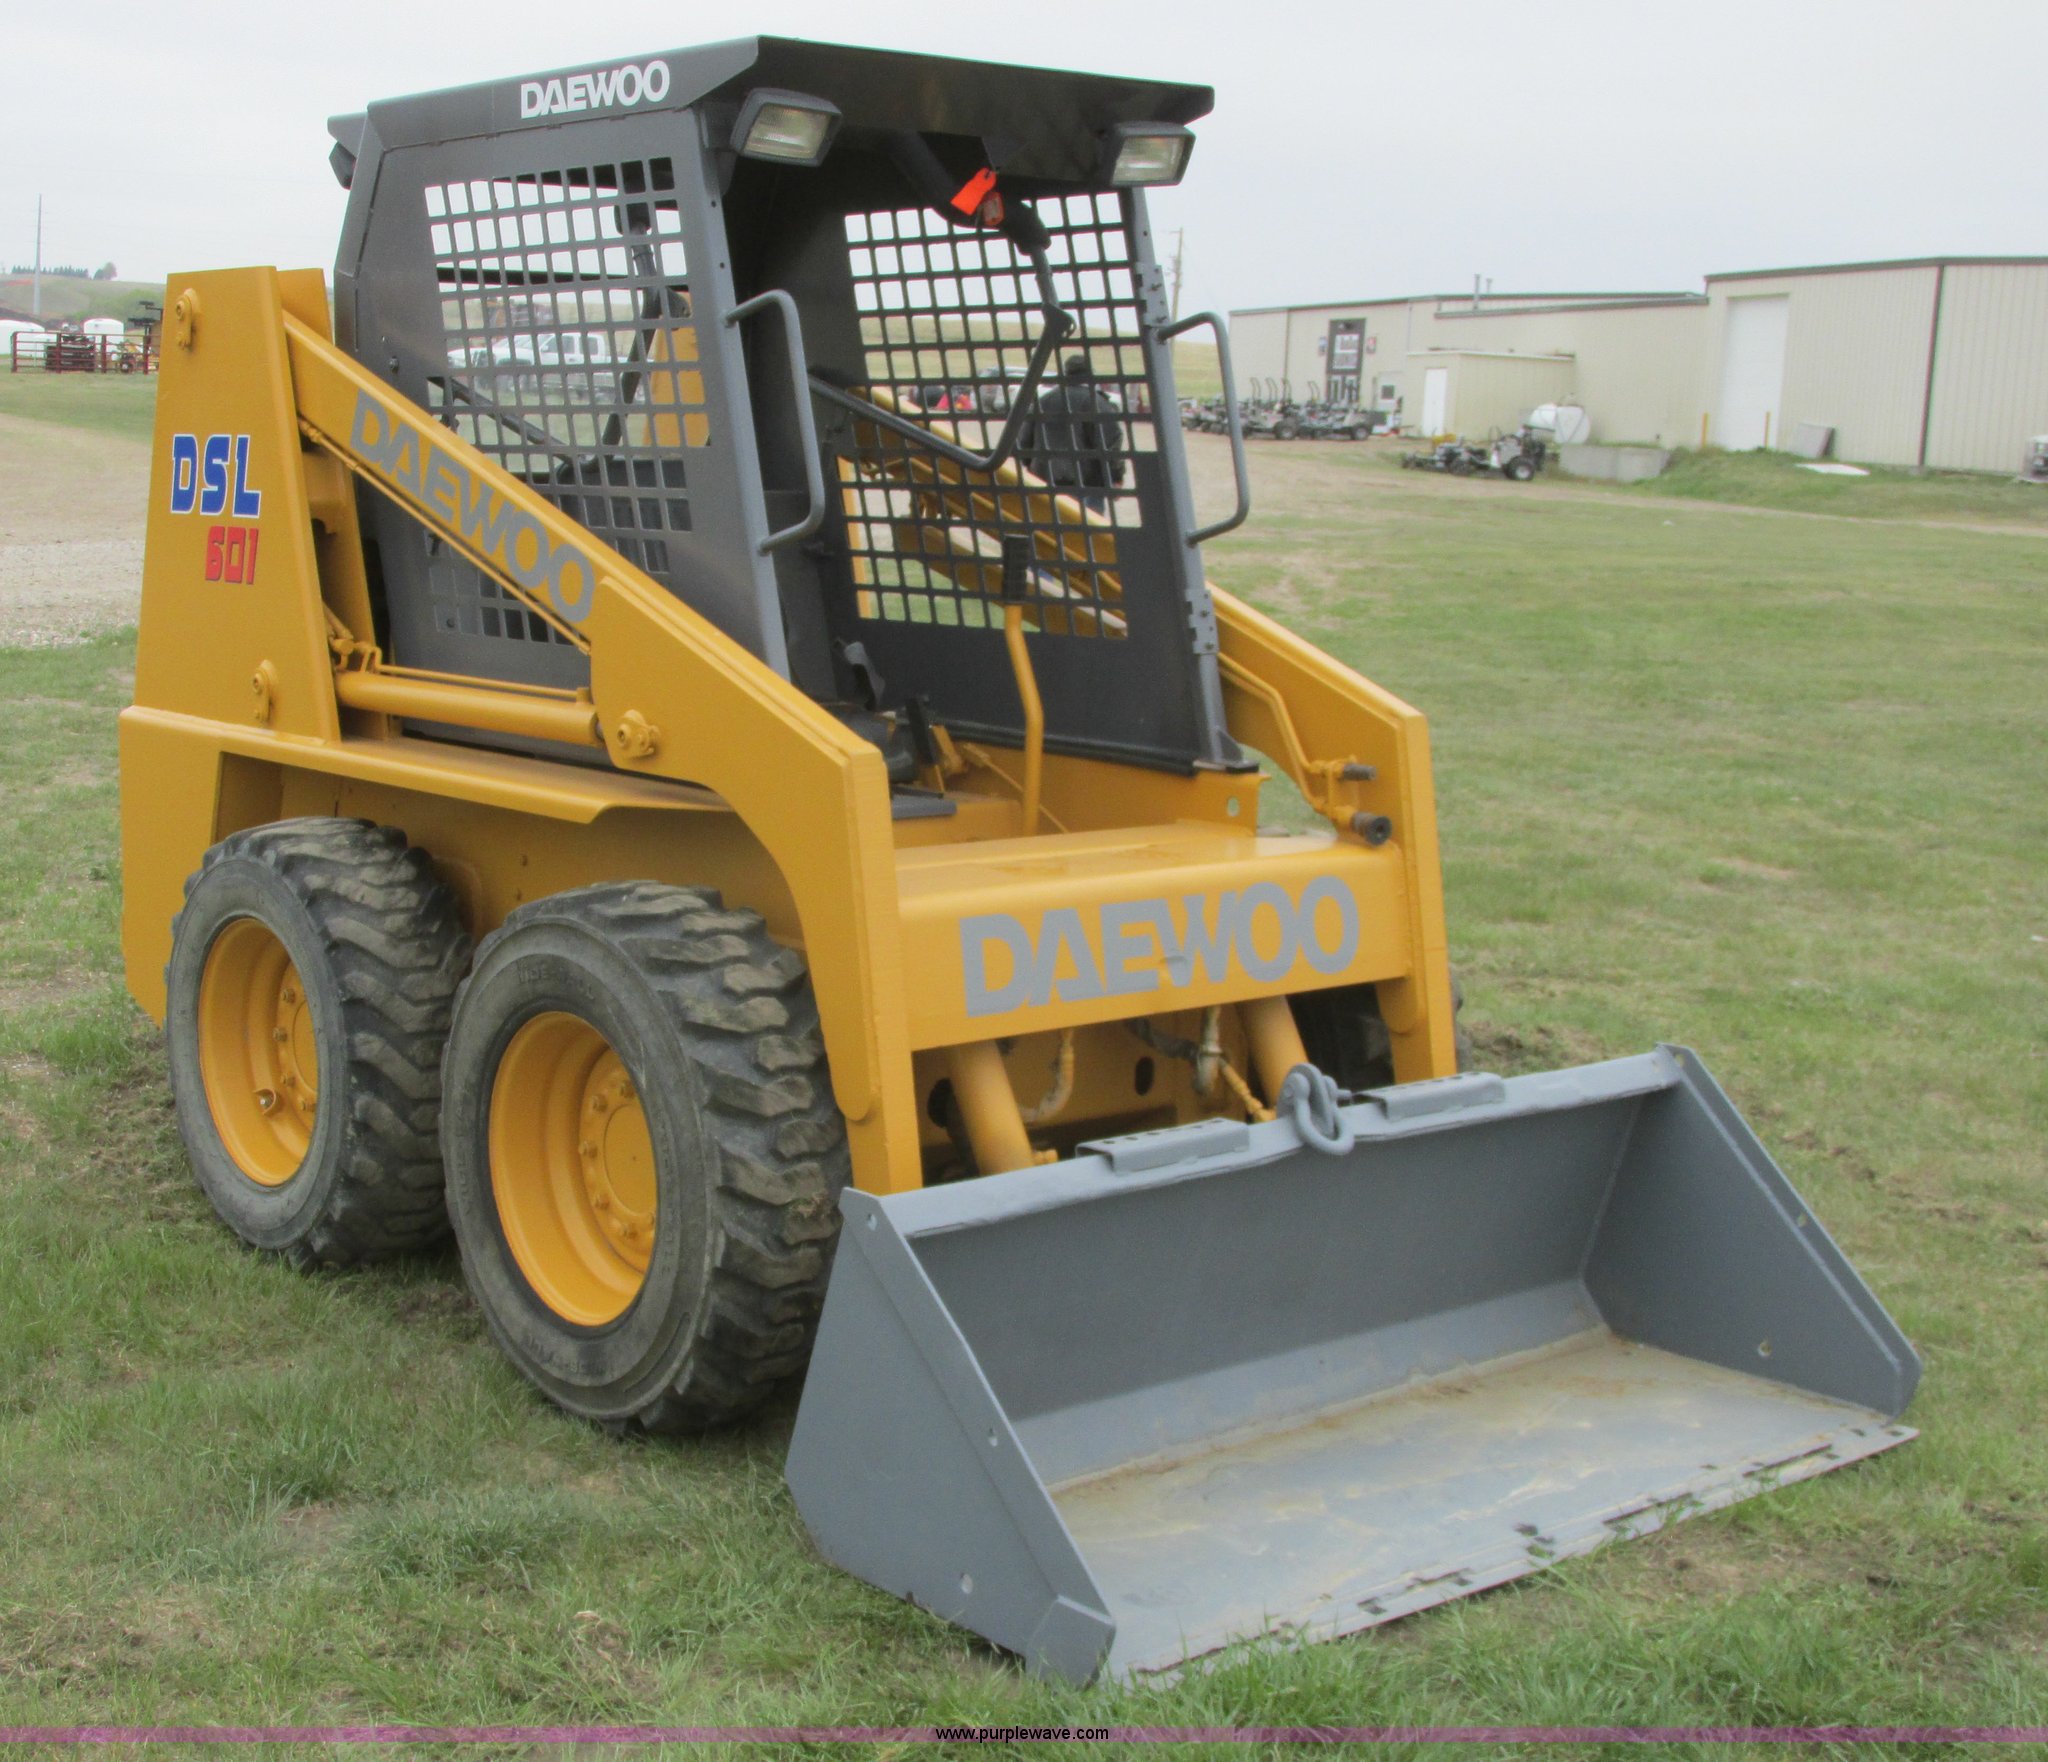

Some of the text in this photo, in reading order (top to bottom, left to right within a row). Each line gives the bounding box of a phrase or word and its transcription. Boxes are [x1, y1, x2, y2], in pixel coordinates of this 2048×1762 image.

[521, 60, 670, 119] DAEWOO
[170, 433, 261, 519] DSL
[351, 388, 596, 623] DAEWOO
[205, 525, 259, 585] 601
[958, 875, 1359, 1018] DAEWOO
